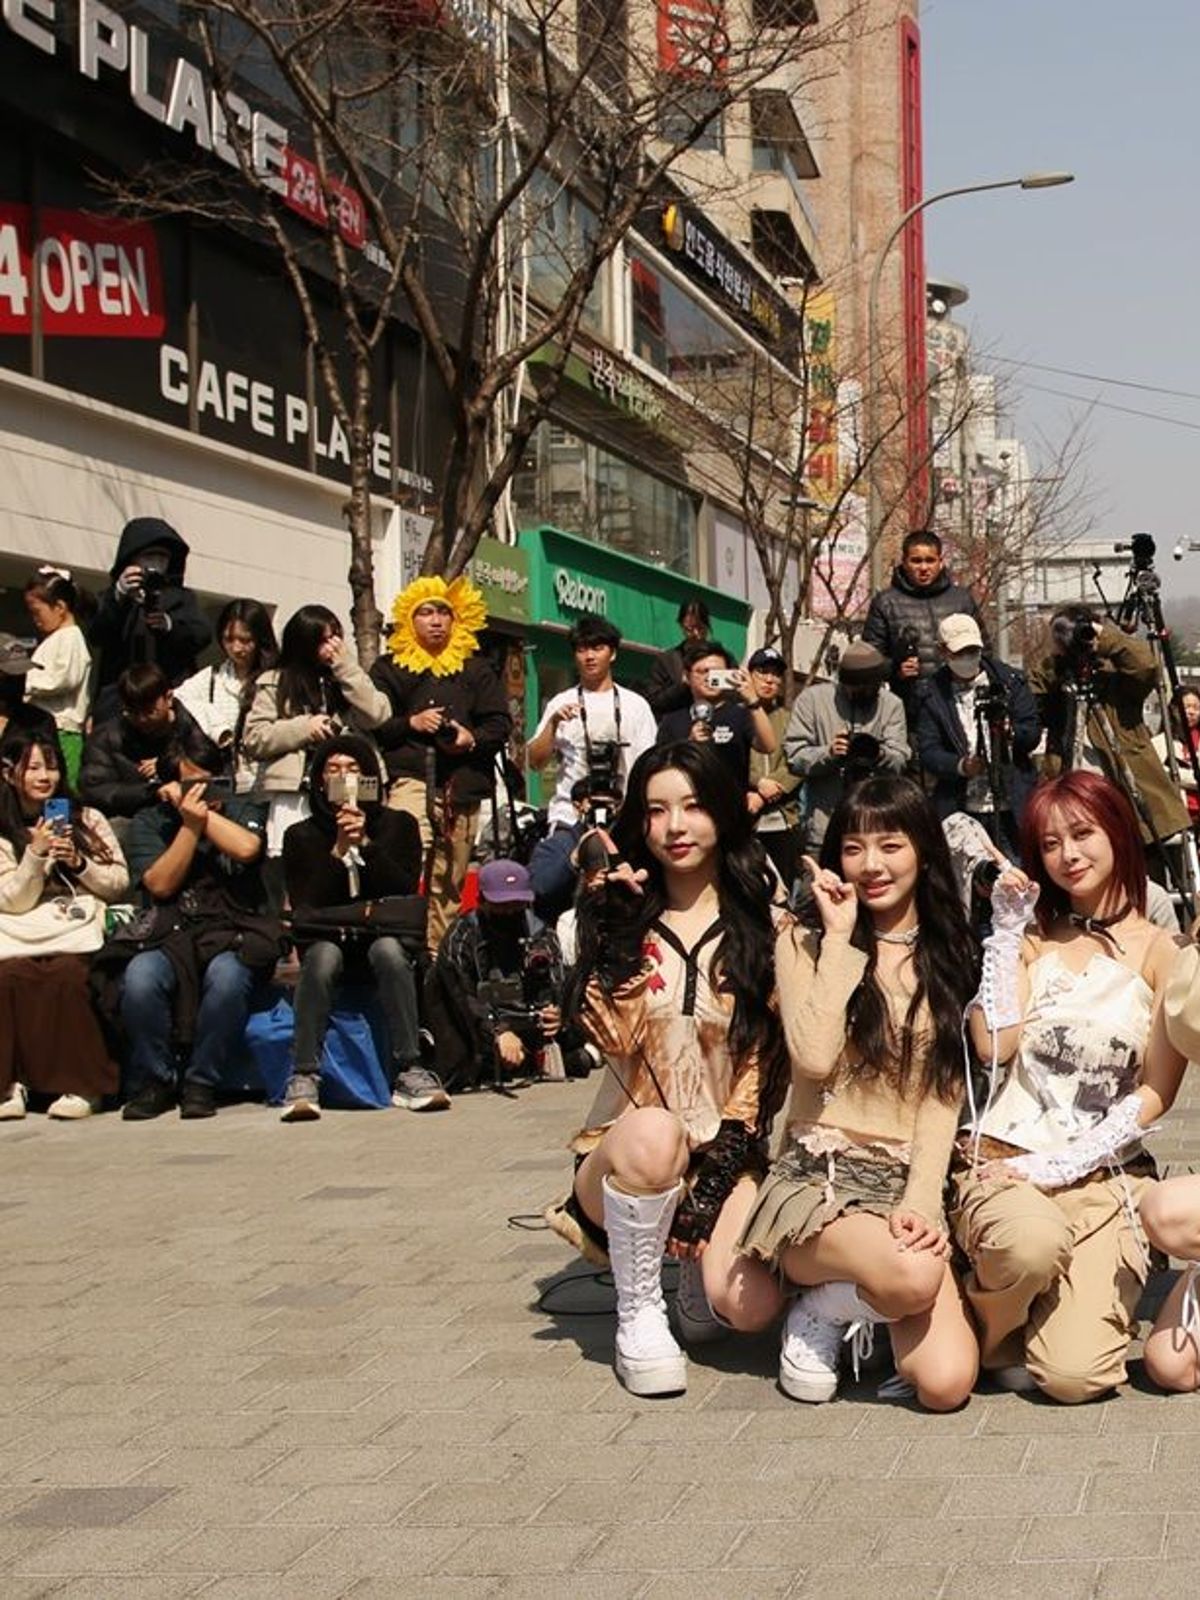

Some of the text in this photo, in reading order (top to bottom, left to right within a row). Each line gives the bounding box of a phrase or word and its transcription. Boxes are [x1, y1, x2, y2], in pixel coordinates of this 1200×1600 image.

[40, 237, 150, 317] OPEN
[160, 343, 392, 480] CAFE PLAE
